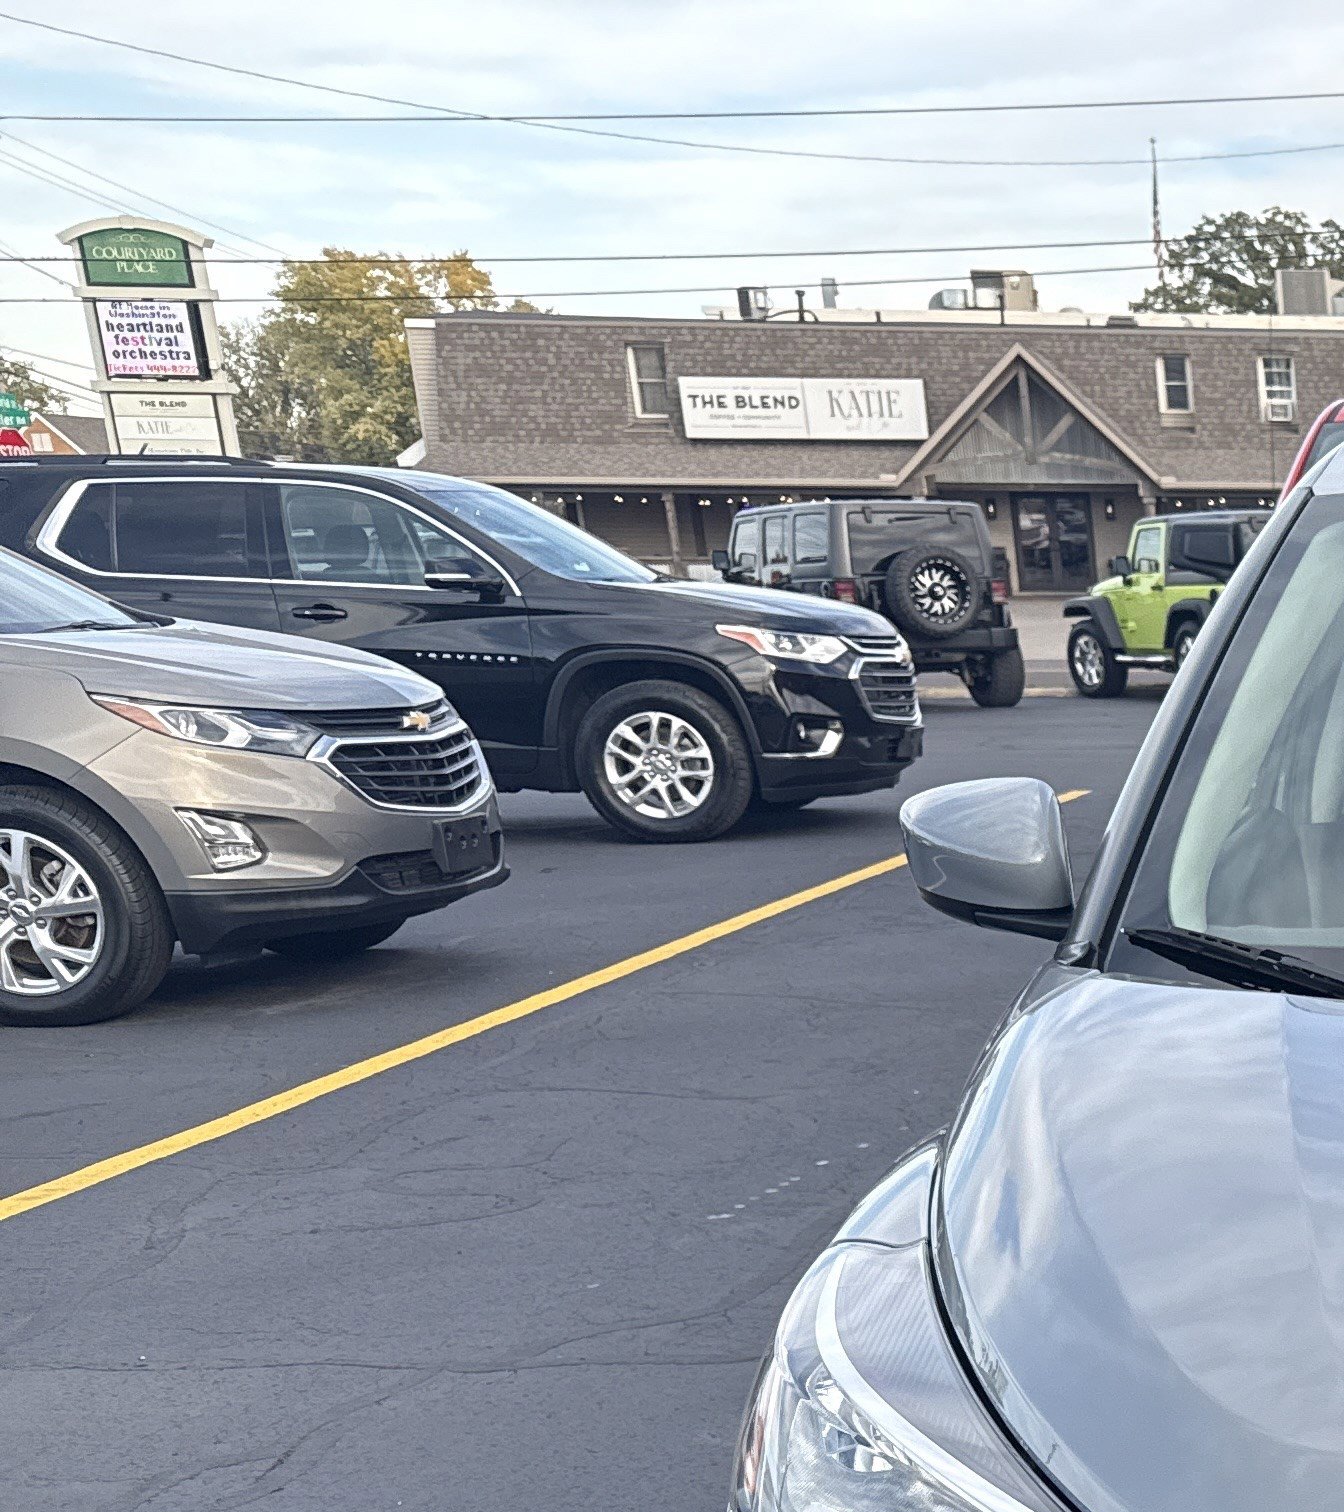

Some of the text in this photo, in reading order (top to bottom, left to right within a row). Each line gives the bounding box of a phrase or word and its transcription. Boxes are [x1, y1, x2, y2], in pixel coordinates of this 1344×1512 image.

[92, 246, 177, 260] COURTYARD
[116, 261, 159, 273] PLACE
[105, 320, 184, 333] heartland
[114, 334, 179, 347] festival
[112, 348, 191, 360] orchestra
[159, 400, 187, 408] BLEND
[687, 394, 800, 409] THE BLEND
[826, 390, 903, 419] KATIE
